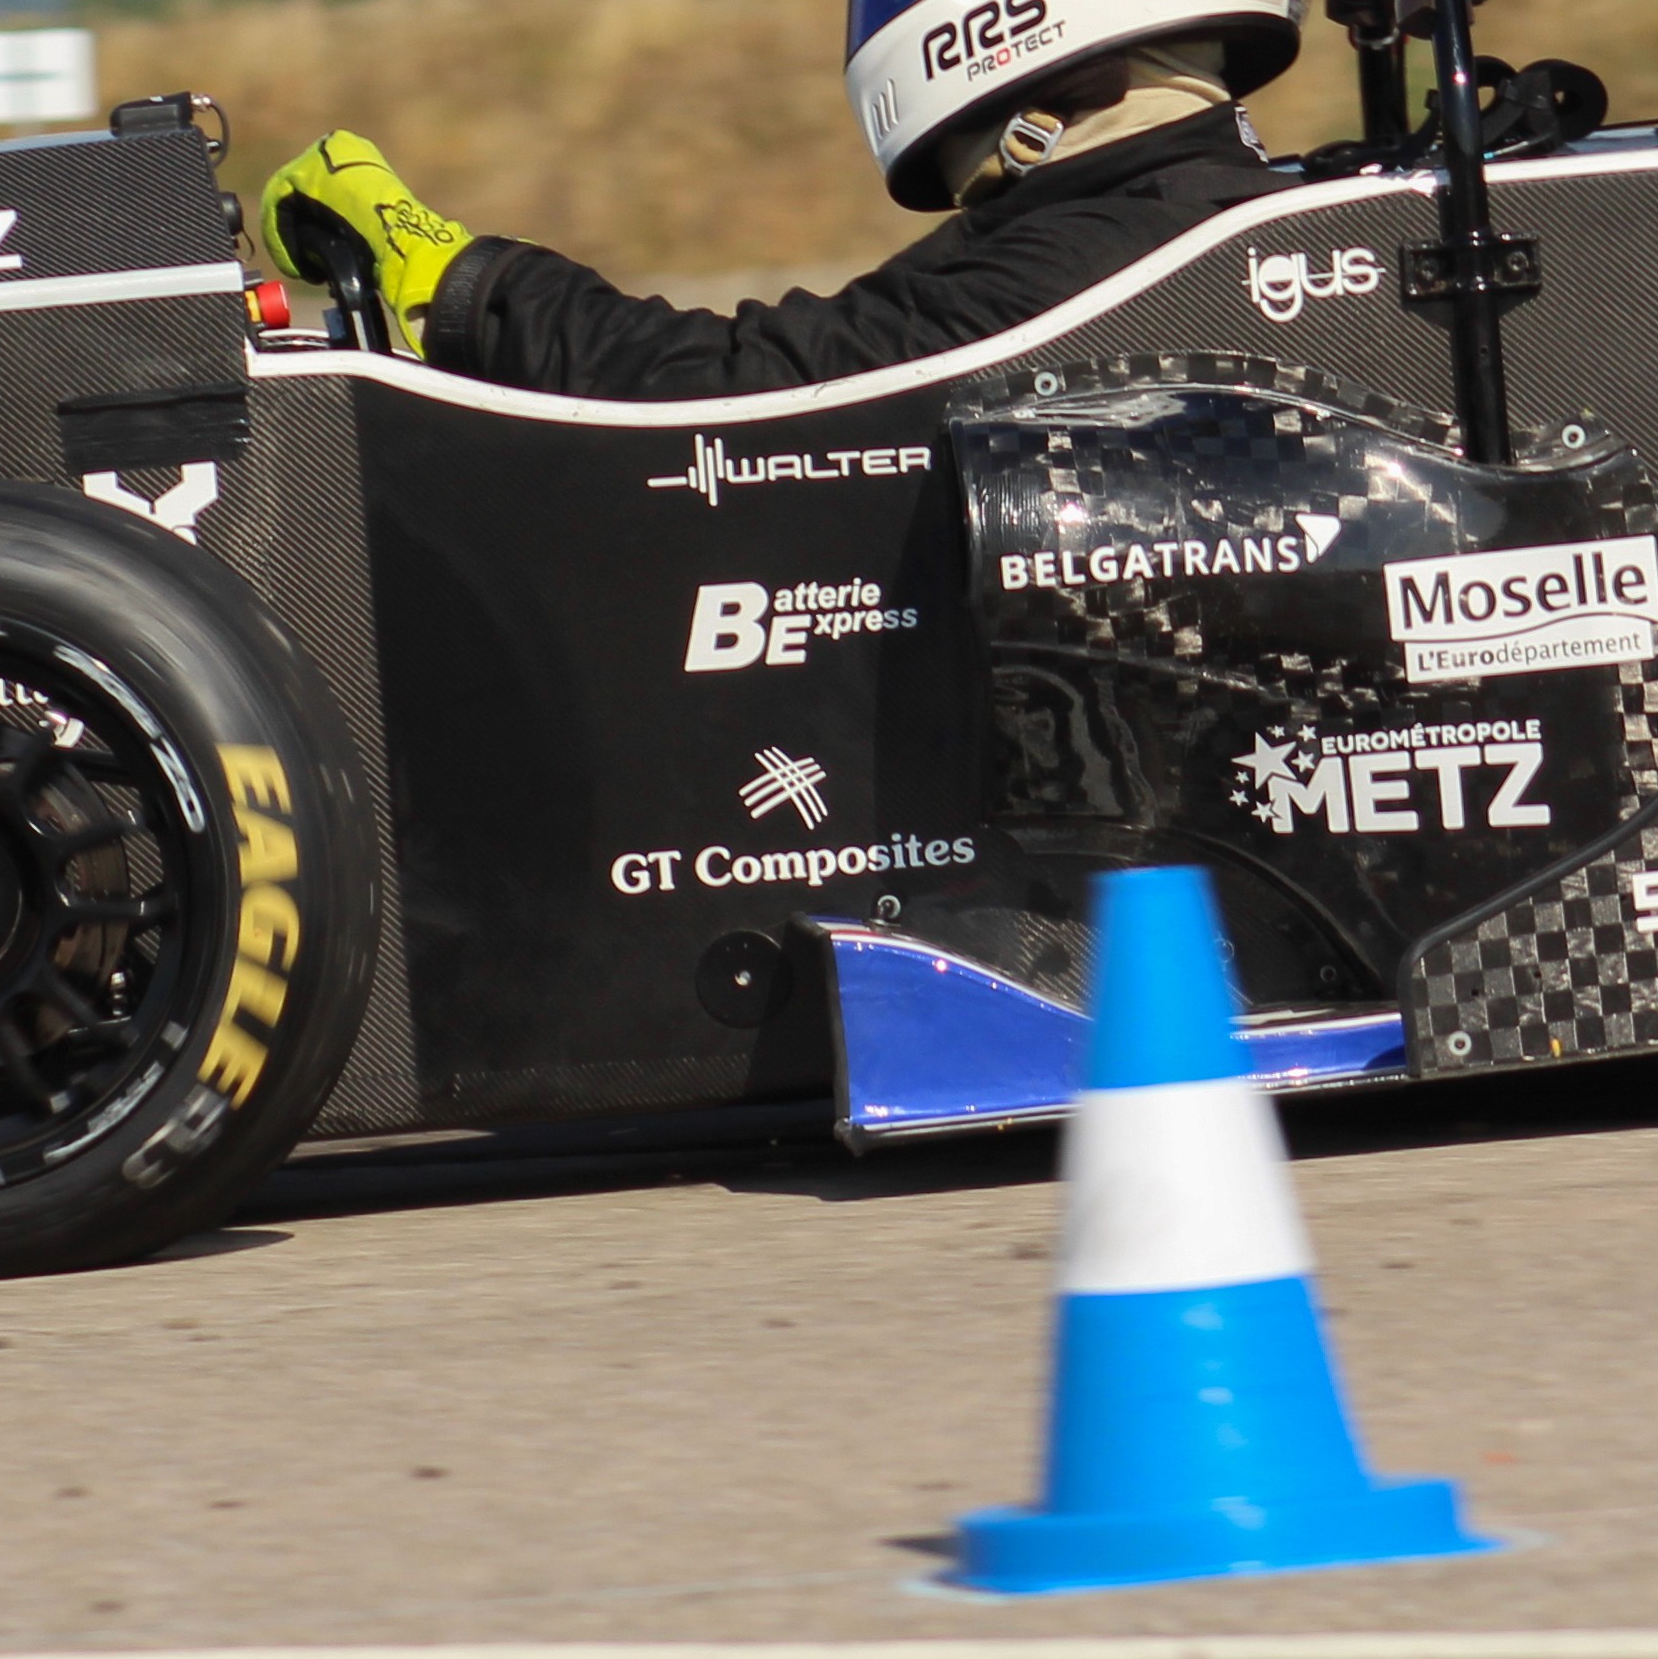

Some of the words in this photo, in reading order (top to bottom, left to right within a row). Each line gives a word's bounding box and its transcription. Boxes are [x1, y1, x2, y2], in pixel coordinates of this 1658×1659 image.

[967, 20, 1066, 81] PROTECT
[1245, 246, 1383, 323] igus
[724, 447, 932, 484] WALTER
[999, 536, 1301, 591] BELGATRANS
[1399, 551, 1649, 630] Moselle
[1417, 632, 1642, 672] L'Eurodépartement
[1320, 723, 1543, 755] EUROMÉTROPOLE
[1268, 742, 1552, 834] METZ
[611, 851, 682, 894] GT
[695, 833, 977, 889] Composites
[197, 742, 300, 1111] EAGLE
